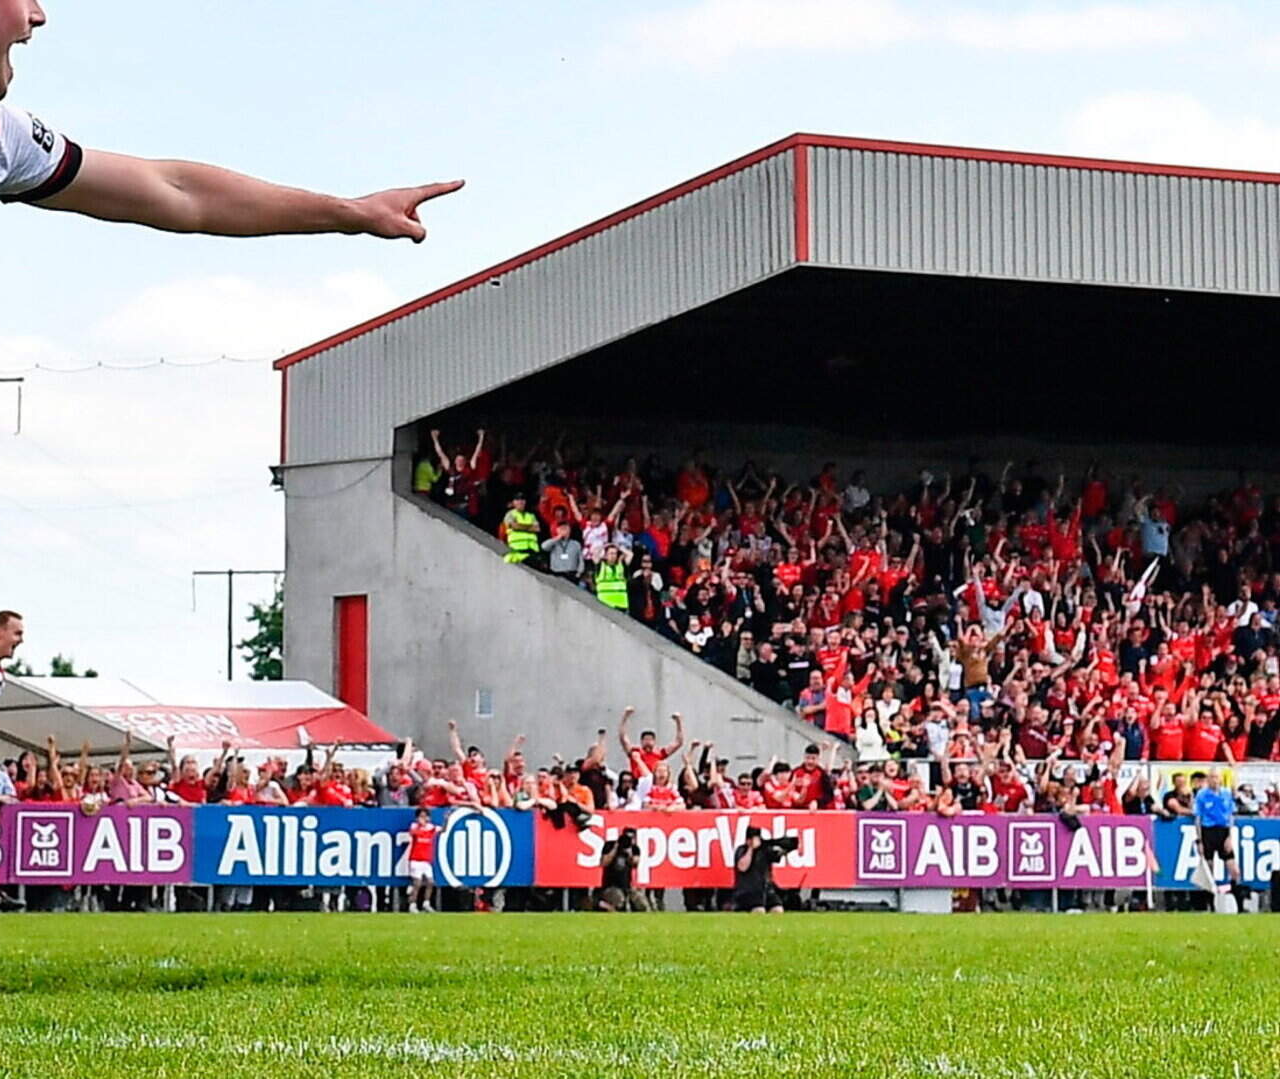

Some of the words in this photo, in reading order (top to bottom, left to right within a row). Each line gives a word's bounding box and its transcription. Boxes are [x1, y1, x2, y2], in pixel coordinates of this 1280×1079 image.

[29, 849, 59, 866] AIB
[83, 817, 184, 872] AIB
[577, 814, 815, 883] SperVlu
[869, 853, 895, 870] AIB
[914, 825, 998, 876] AIB
[1019, 856, 1045, 872] AIB
[1064, 826, 1146, 877] AIB
